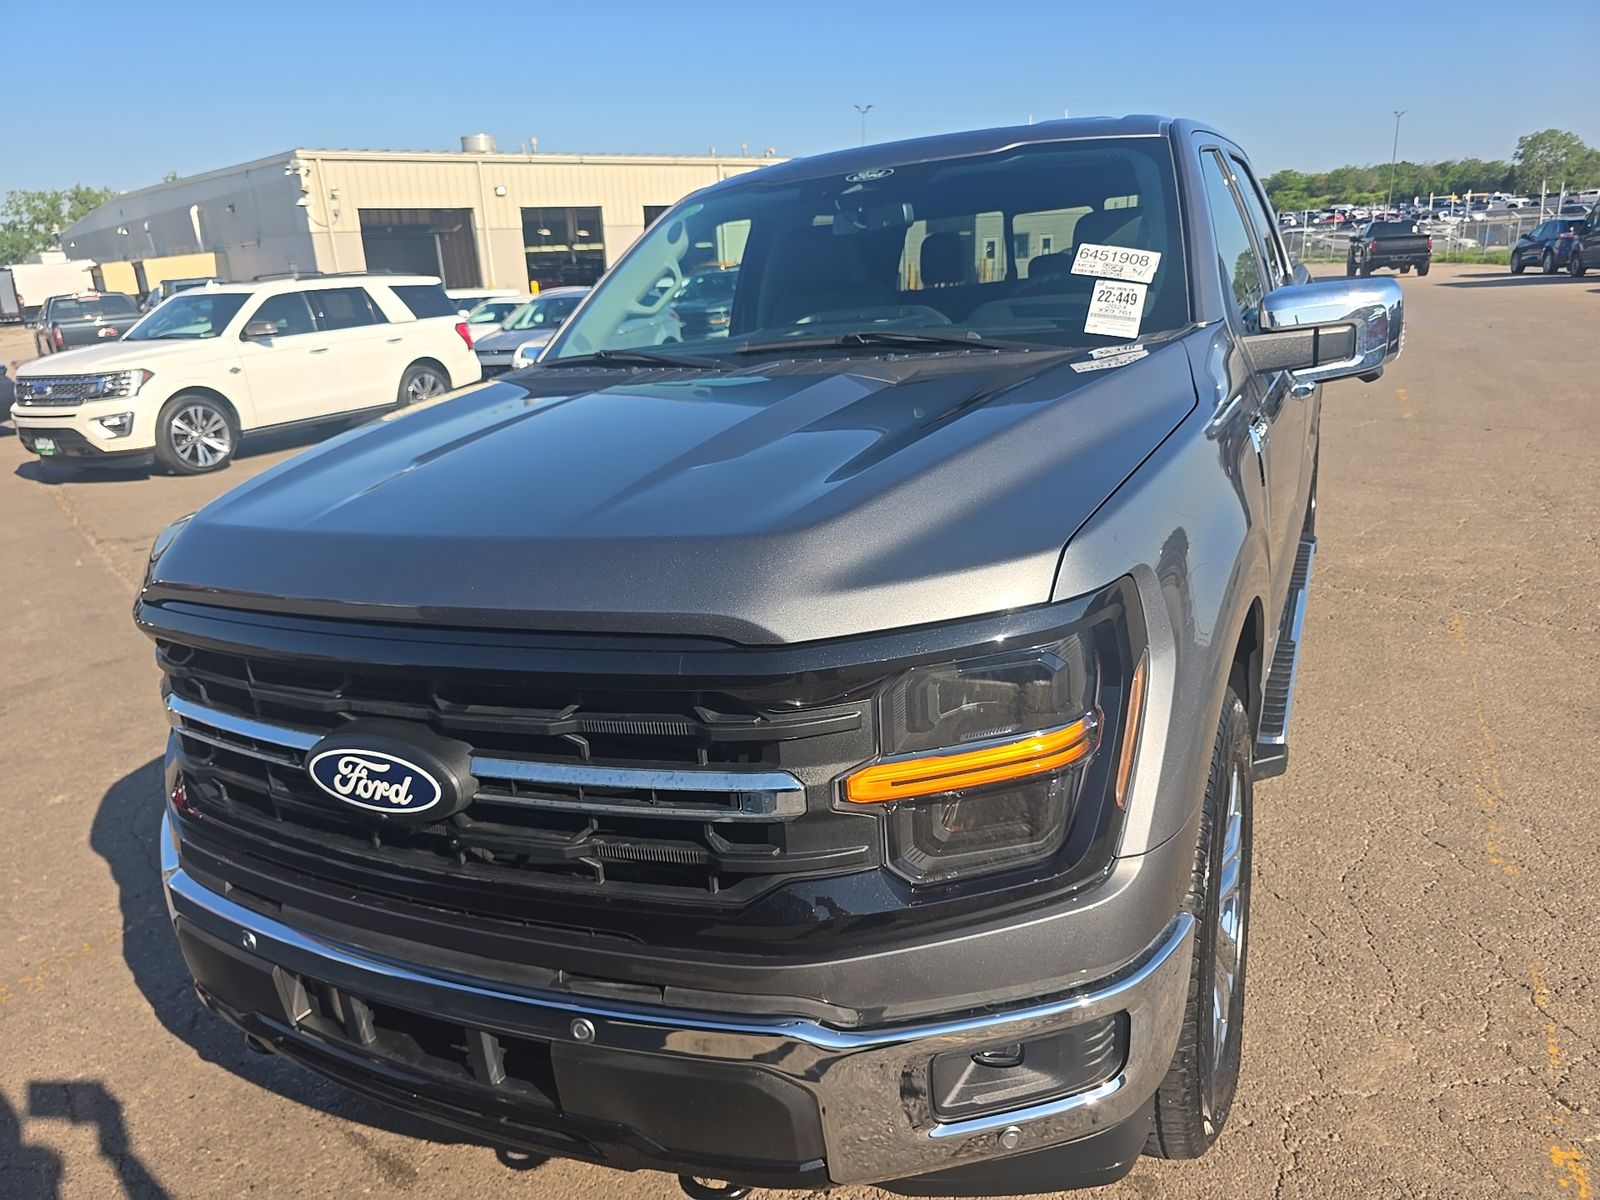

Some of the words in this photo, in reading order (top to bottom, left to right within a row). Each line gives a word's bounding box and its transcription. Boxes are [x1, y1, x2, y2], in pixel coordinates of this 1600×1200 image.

[1079, 247, 1150, 267] 6451908
[1097, 289, 1138, 306] 22:449
[333, 756, 414, 806] Ford
